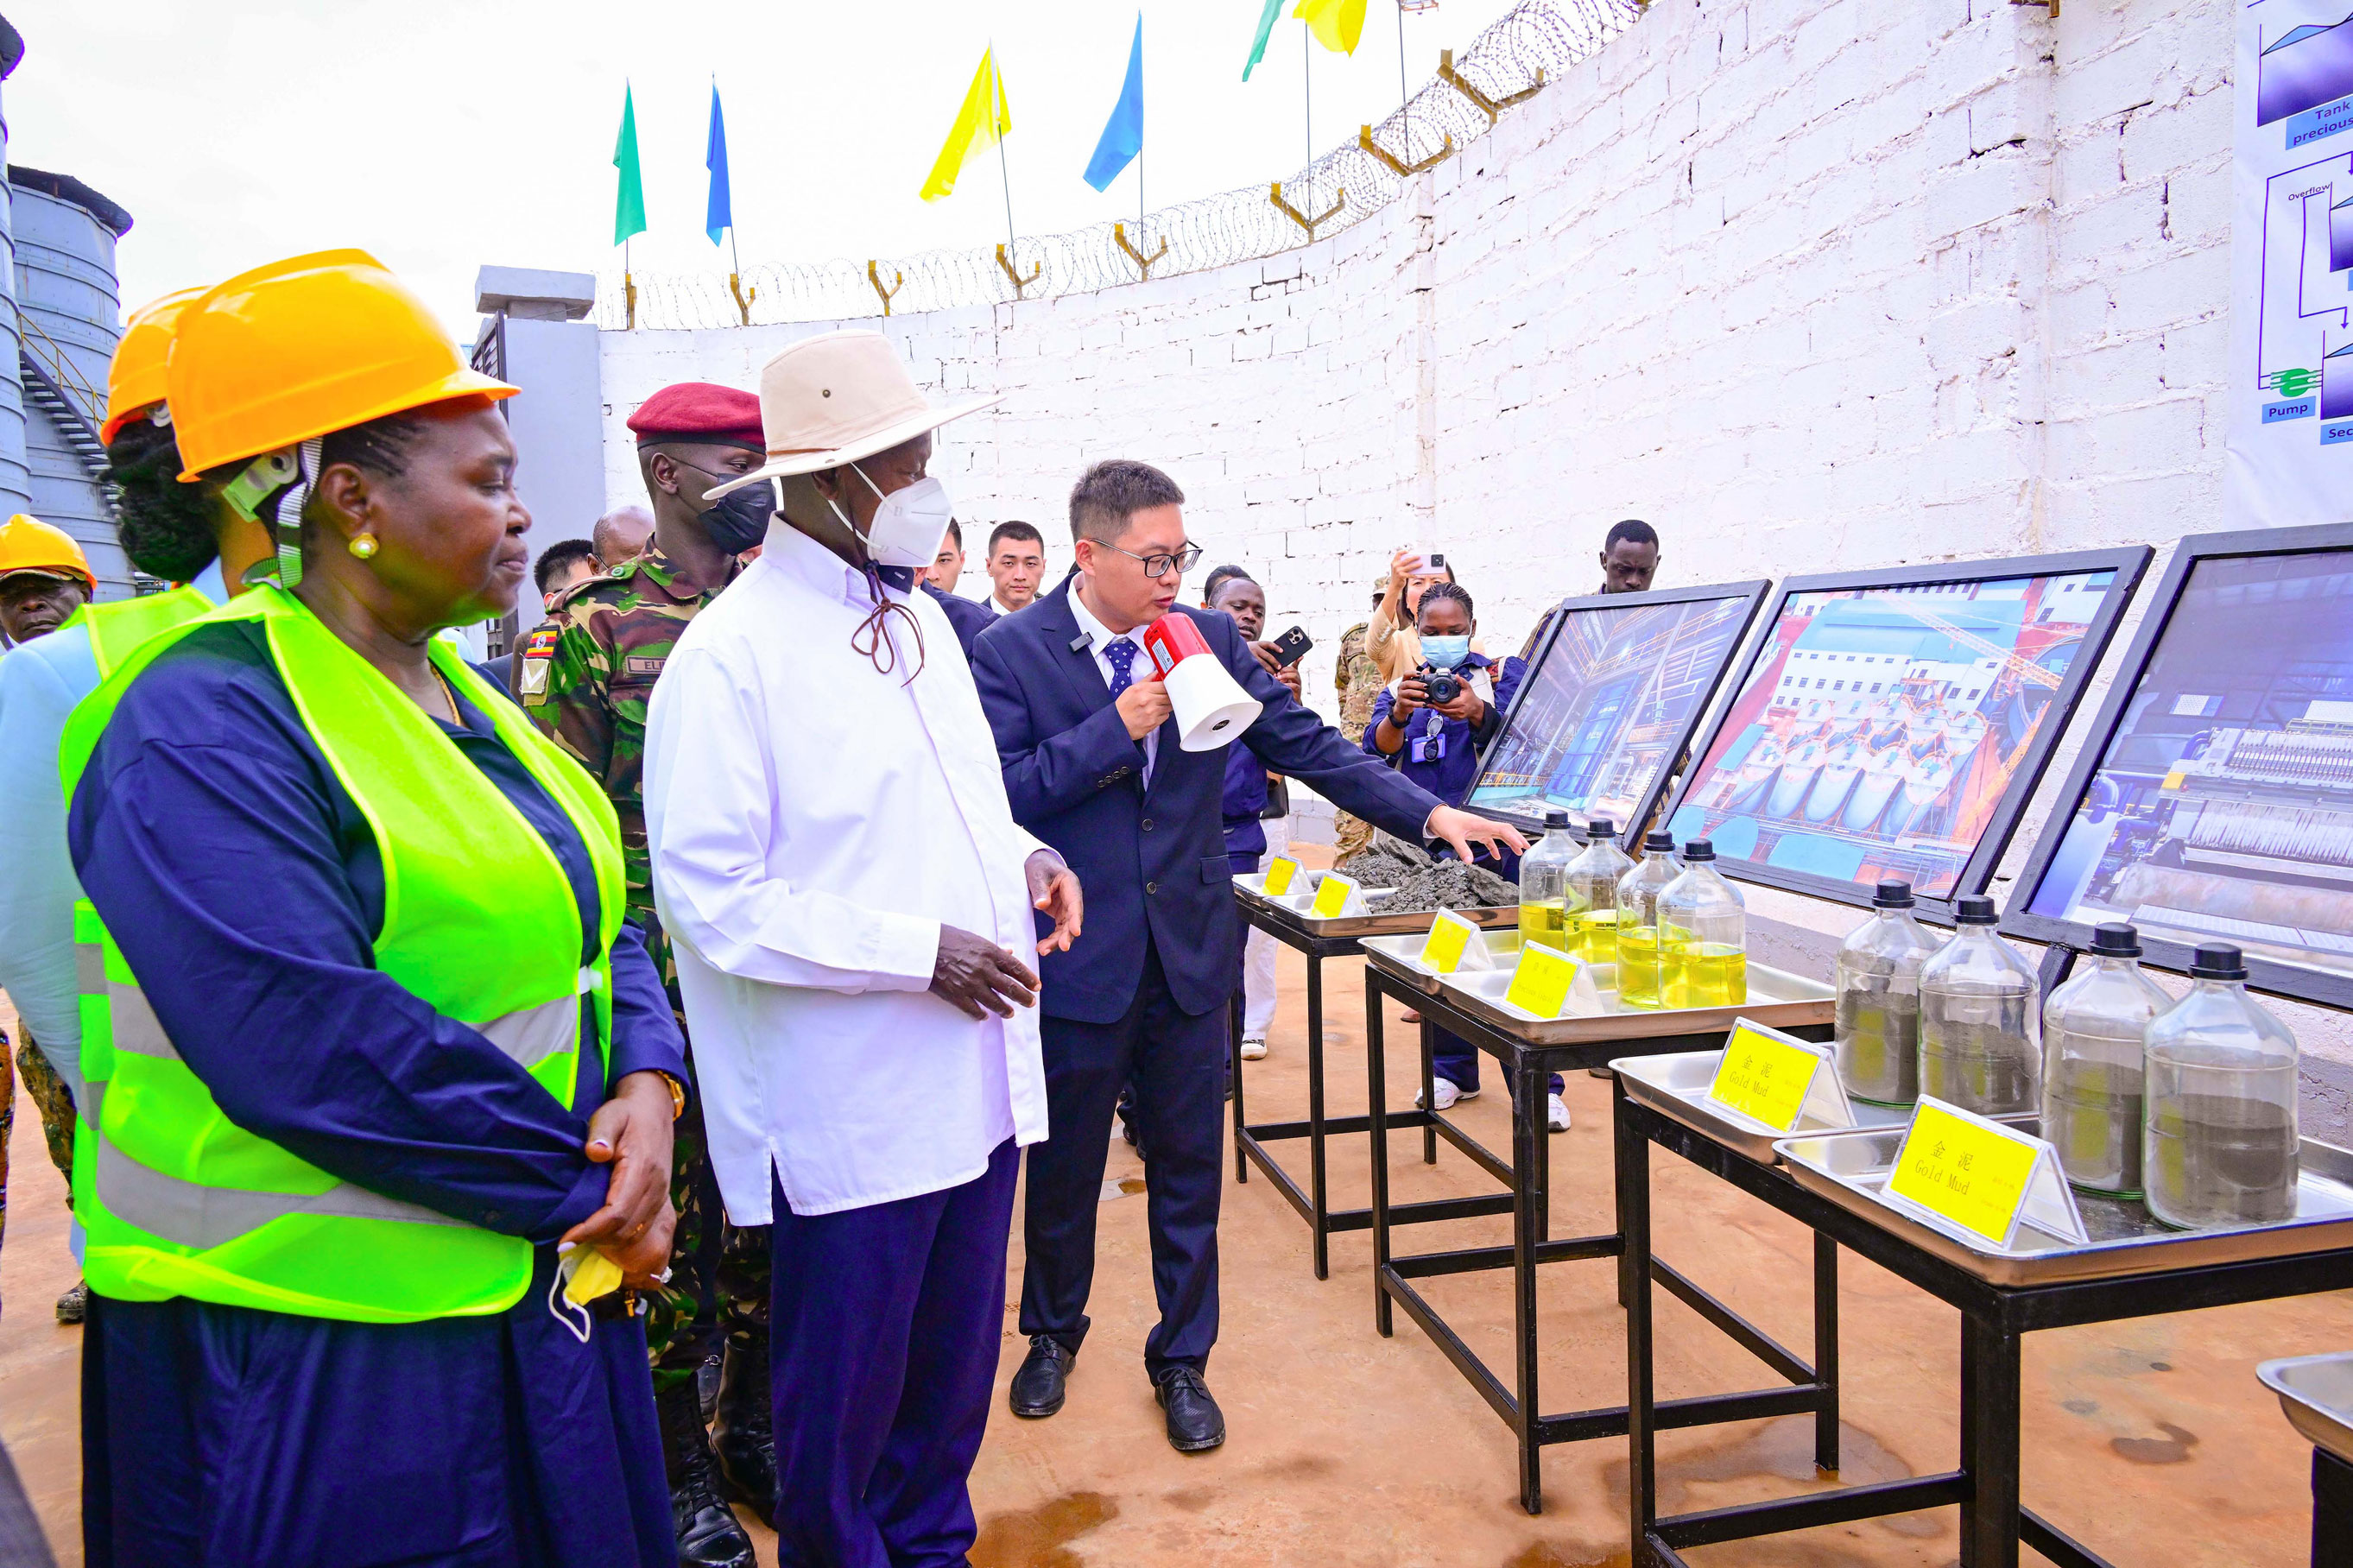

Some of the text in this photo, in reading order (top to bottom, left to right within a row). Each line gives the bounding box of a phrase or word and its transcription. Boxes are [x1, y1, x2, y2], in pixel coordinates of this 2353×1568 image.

[2315, 101, 2350, 120] Tank
[2293, 117, 2353, 146] precious
[2288, 183, 2331, 200] Overflow
[2269, 404, 2308, 417] Pump
[2328, 428, 2353, 439] Sec
[1730, 1071, 1750, 1089] Gold
[1753, 1080, 1769, 1097] Mud
[1915, 1160, 1944, 1183] Gold
[1946, 1173, 1970, 1195] Mud
